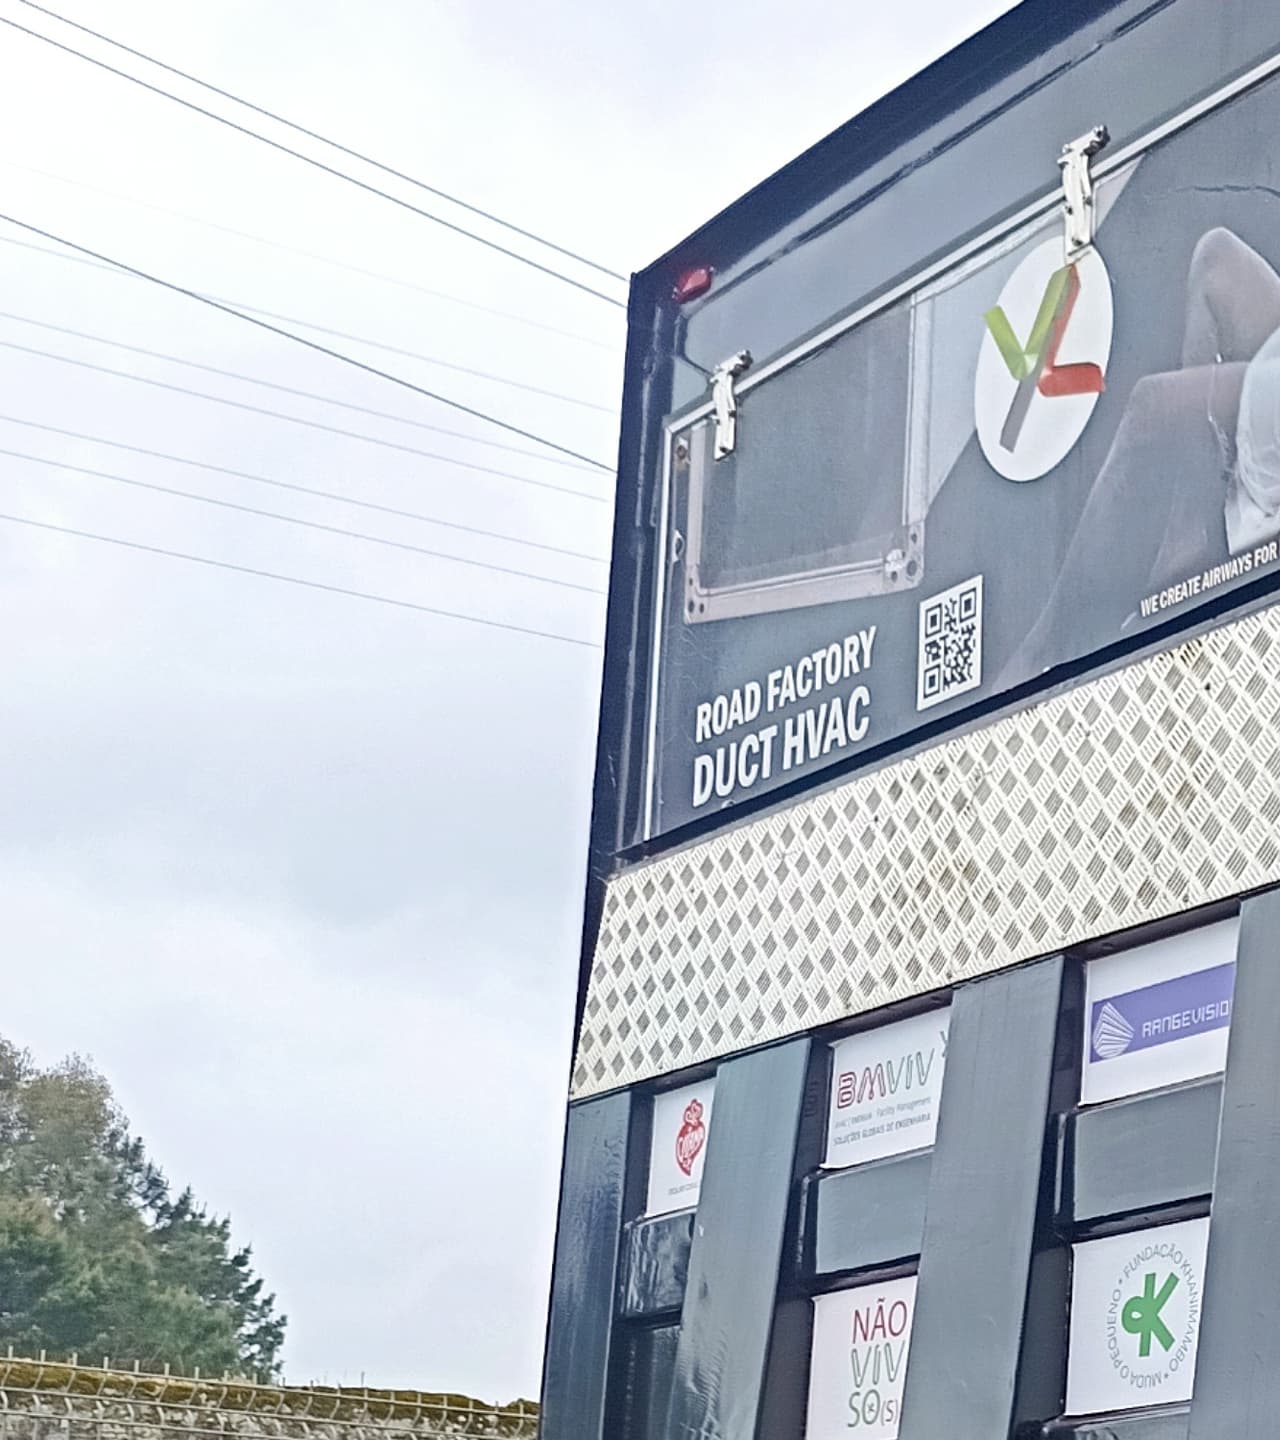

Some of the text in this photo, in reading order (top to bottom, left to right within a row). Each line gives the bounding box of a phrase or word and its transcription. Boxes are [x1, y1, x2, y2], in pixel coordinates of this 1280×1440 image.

[1140, 593, 1159, 618] WE
[1160, 574, 1201, 610] CREATE
[1201, 552, 1252, 593] AIRWAYS
[1254, 541, 1277, 569] FOR
[695, 626, 877, 744] ROAD FACTORY
[692, 685, 871, 808] DUCT HVAC
[1142, 999, 1233, 1038] RANGEVISIO
[837, 1047, 935, 1109] BMVIV
[852, 1297, 908, 1345] NÃO
[1106, 1288, 1122, 1369] PEQUENO
[1124, 1242, 1200, 1373] FUNDAÇÃO KHANIMAMBO
[851, 1340, 906, 1389] VIV
[1129, 1371, 1163, 1389] MUDA
